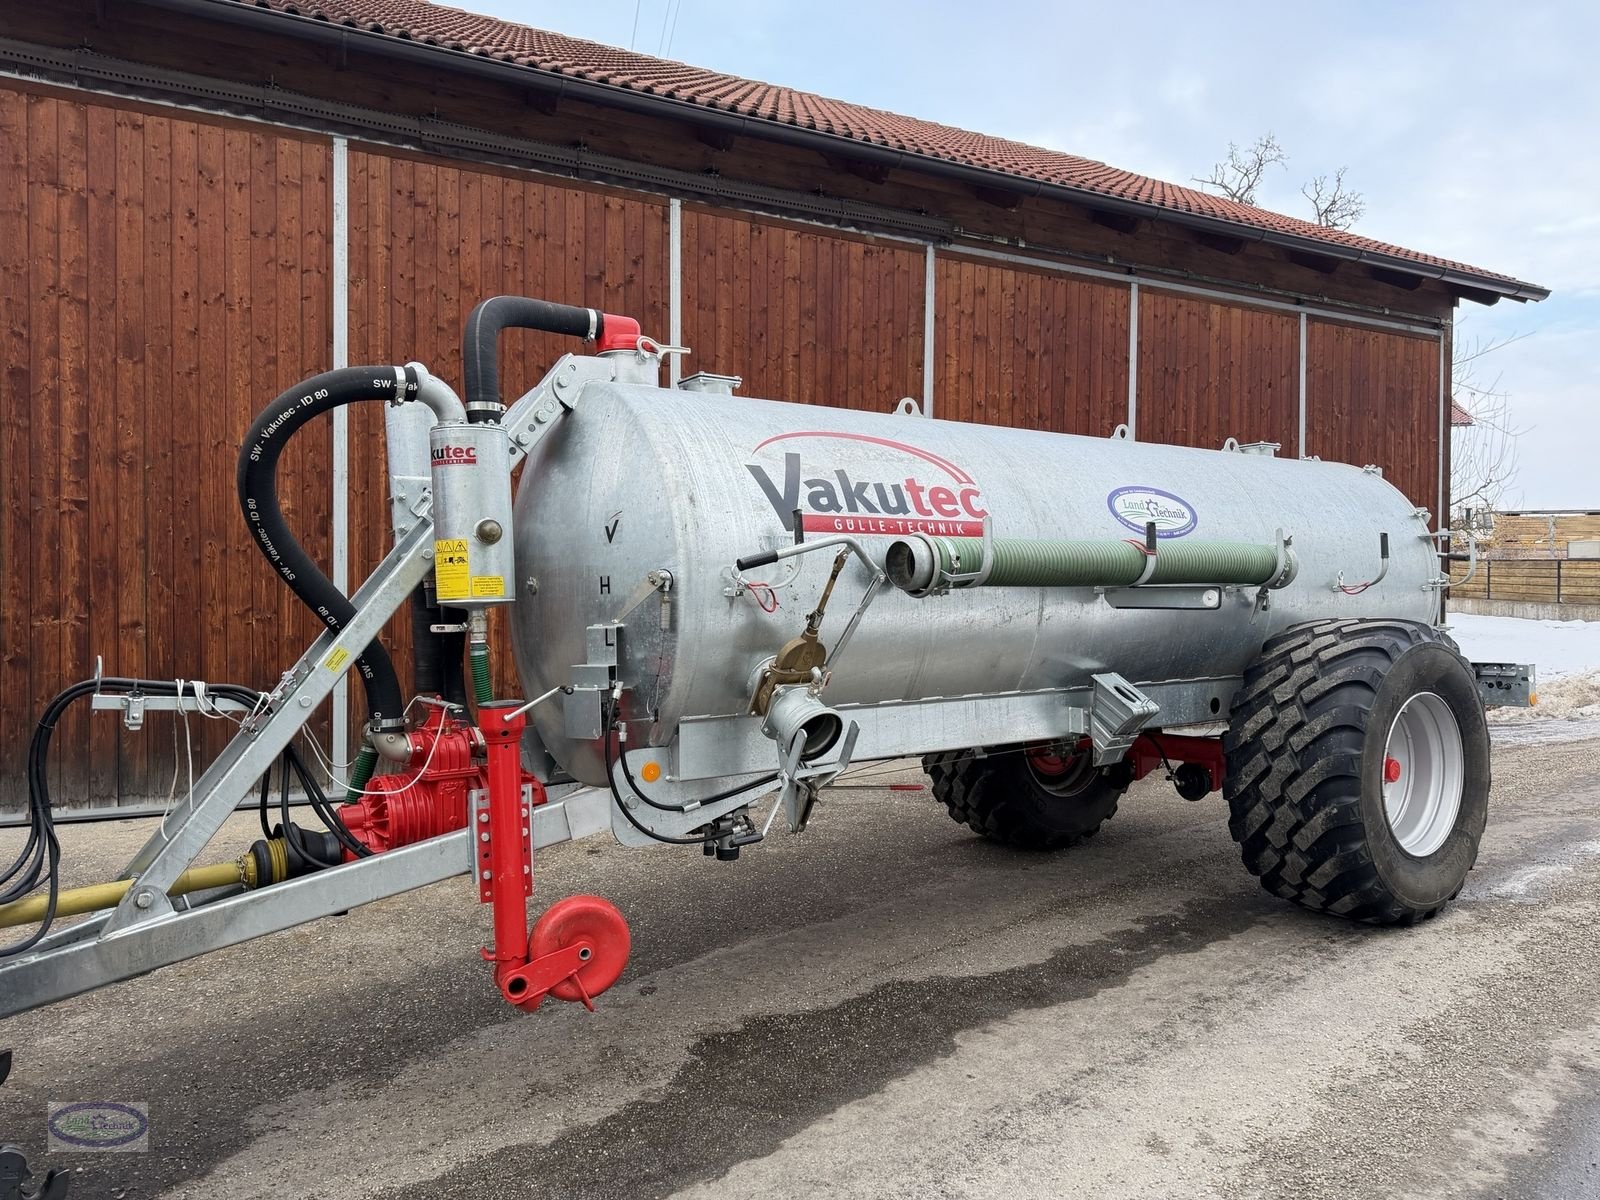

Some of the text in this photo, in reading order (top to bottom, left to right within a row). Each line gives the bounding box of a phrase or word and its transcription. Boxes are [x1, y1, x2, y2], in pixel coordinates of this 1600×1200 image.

[373, 379, 391, 388] SW
[250, 444, 261, 462] SW
[261, 406, 296, 439] Vakutec
[300, 394, 314, 407] ID
[314, 388, 329, 400] 80
[431, 445, 476, 460] kutec
[744, 452, 989, 532] Vakutec
[247, 498, 257, 510] 80
[1122, 499, 1188, 519] Land Technik
[250, 511, 260, 521] ID
[605, 519, 619, 544] V
[834, 517, 965, 535] GÜLLE-TECHNIK
[257, 528, 281, 562] Vakutec
[281, 566, 296, 580] SW
[600, 576, 611, 594] H
[318, 606, 329, 617] 80
[361, 665, 374, 679] SW
